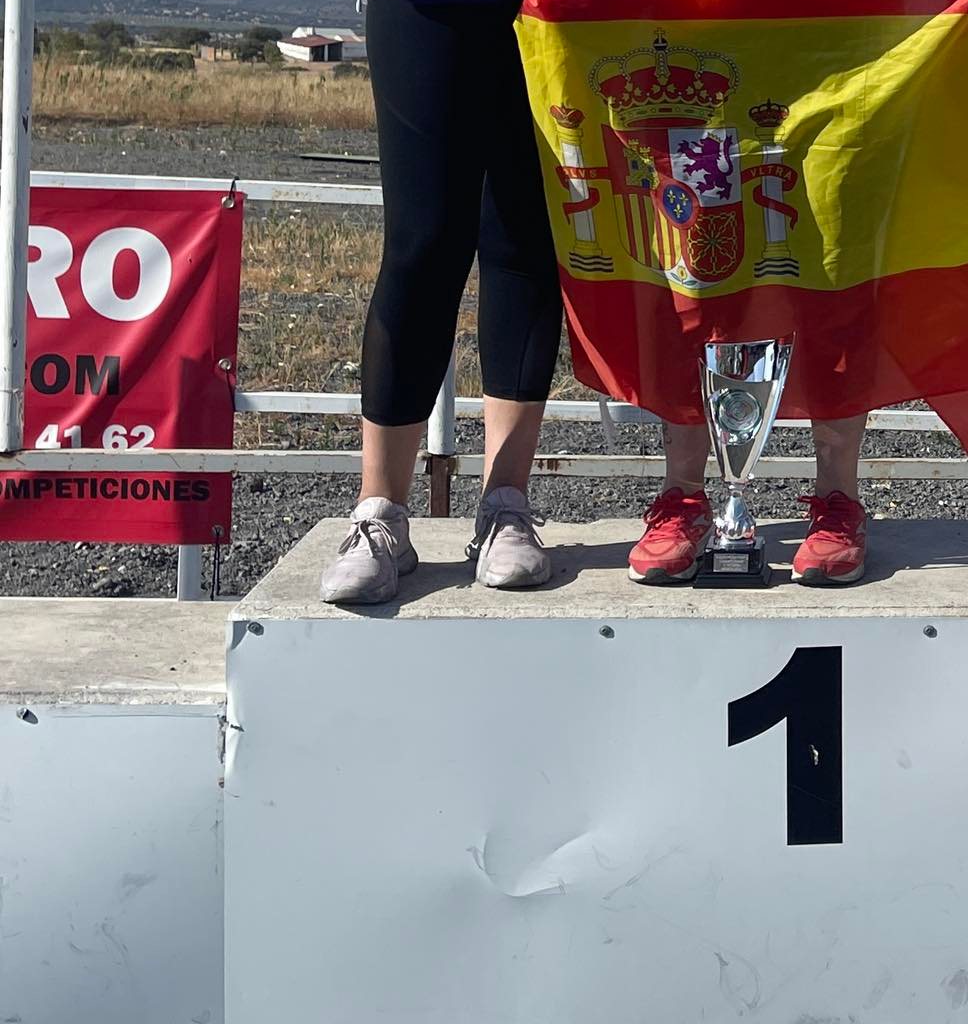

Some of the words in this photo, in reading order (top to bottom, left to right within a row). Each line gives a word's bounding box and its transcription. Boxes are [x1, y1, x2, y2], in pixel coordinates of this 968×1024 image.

[750, 165, 792, 181] VLTRA
[25, 353, 120, 396] OM
[35, 424, 82, 450] 41
[102, 424, 155, 451] 62
[0, 477, 211, 502] MPETICIONES
[728, 646, 843, 846] 1
